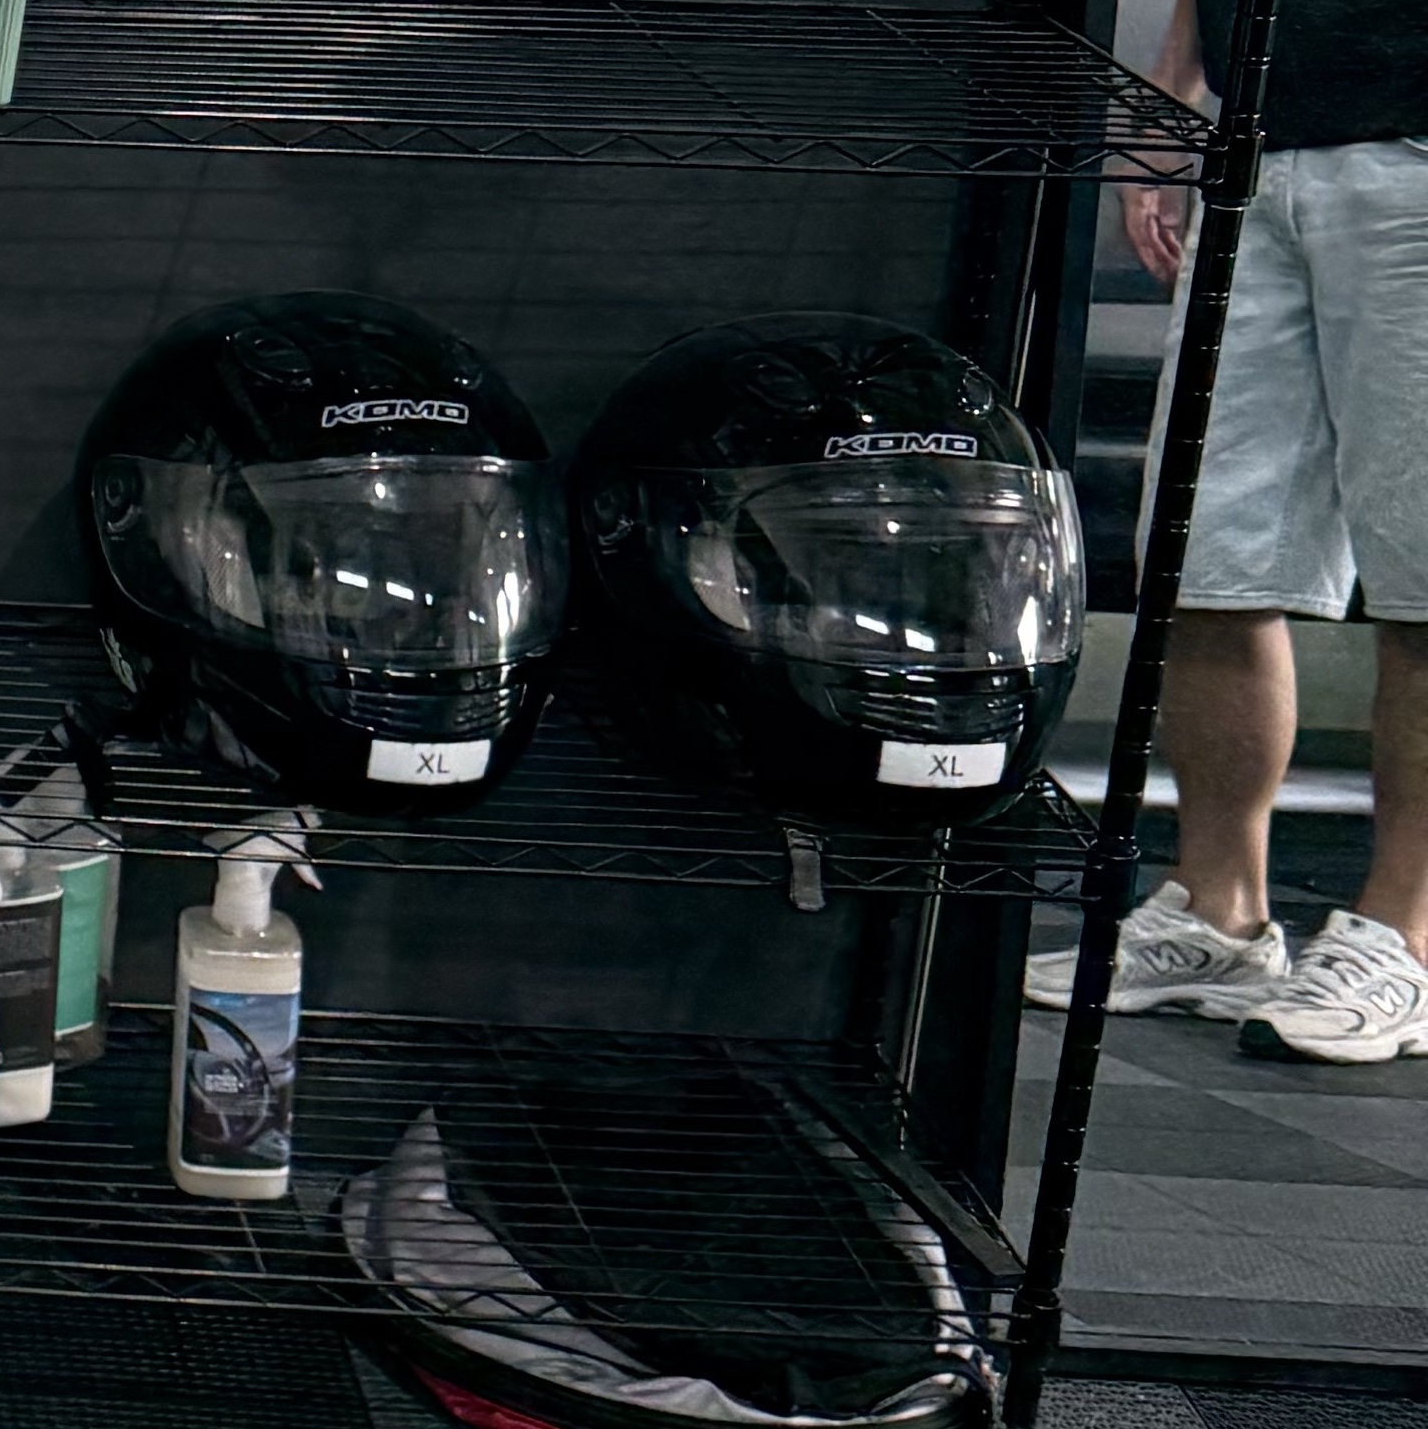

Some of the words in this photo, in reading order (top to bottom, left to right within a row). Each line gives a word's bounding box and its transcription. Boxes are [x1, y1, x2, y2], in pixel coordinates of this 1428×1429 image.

[321, 399, 469, 428] KOMO
[824, 432, 978, 458] KOMO
[416, 753, 450, 774] XL
[928, 754, 964, 777] XL
